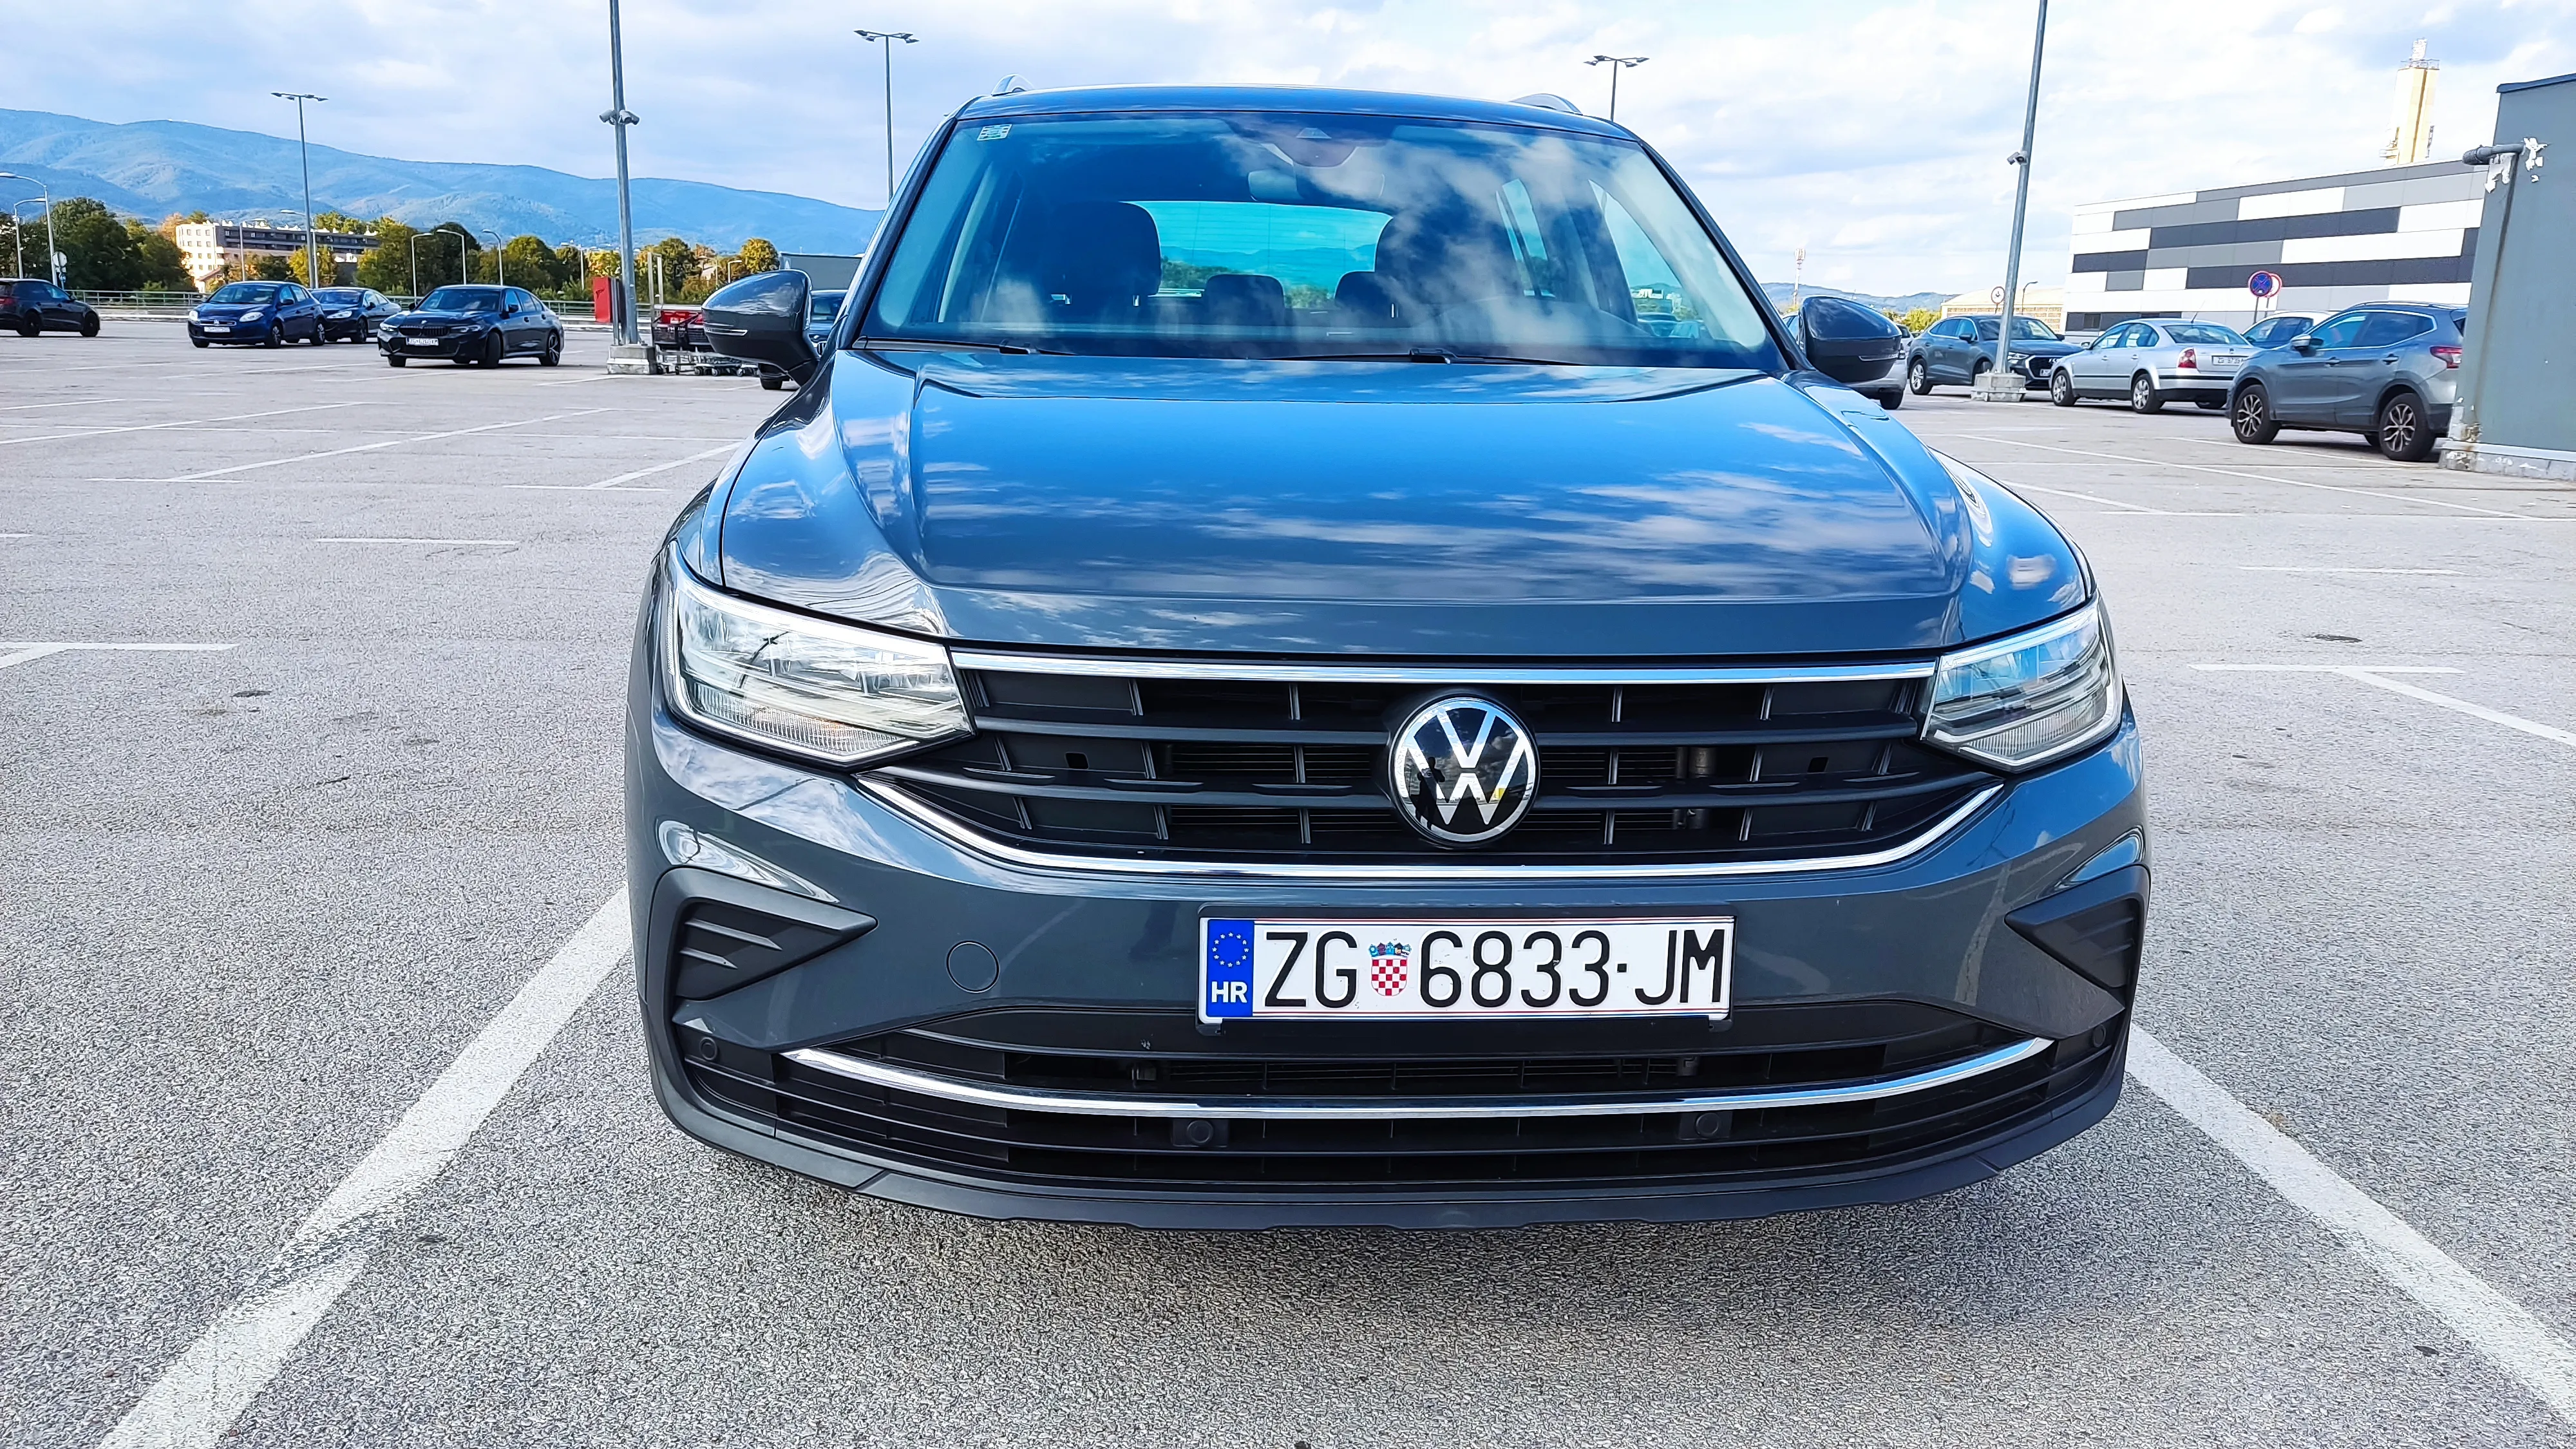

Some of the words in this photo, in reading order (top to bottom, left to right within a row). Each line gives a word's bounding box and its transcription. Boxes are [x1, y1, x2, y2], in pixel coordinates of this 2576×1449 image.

[1399, 702, 1530, 828] VW
[1211, 981, 1247, 1003] HR
[1264, 931, 1358, 1008] ZG
